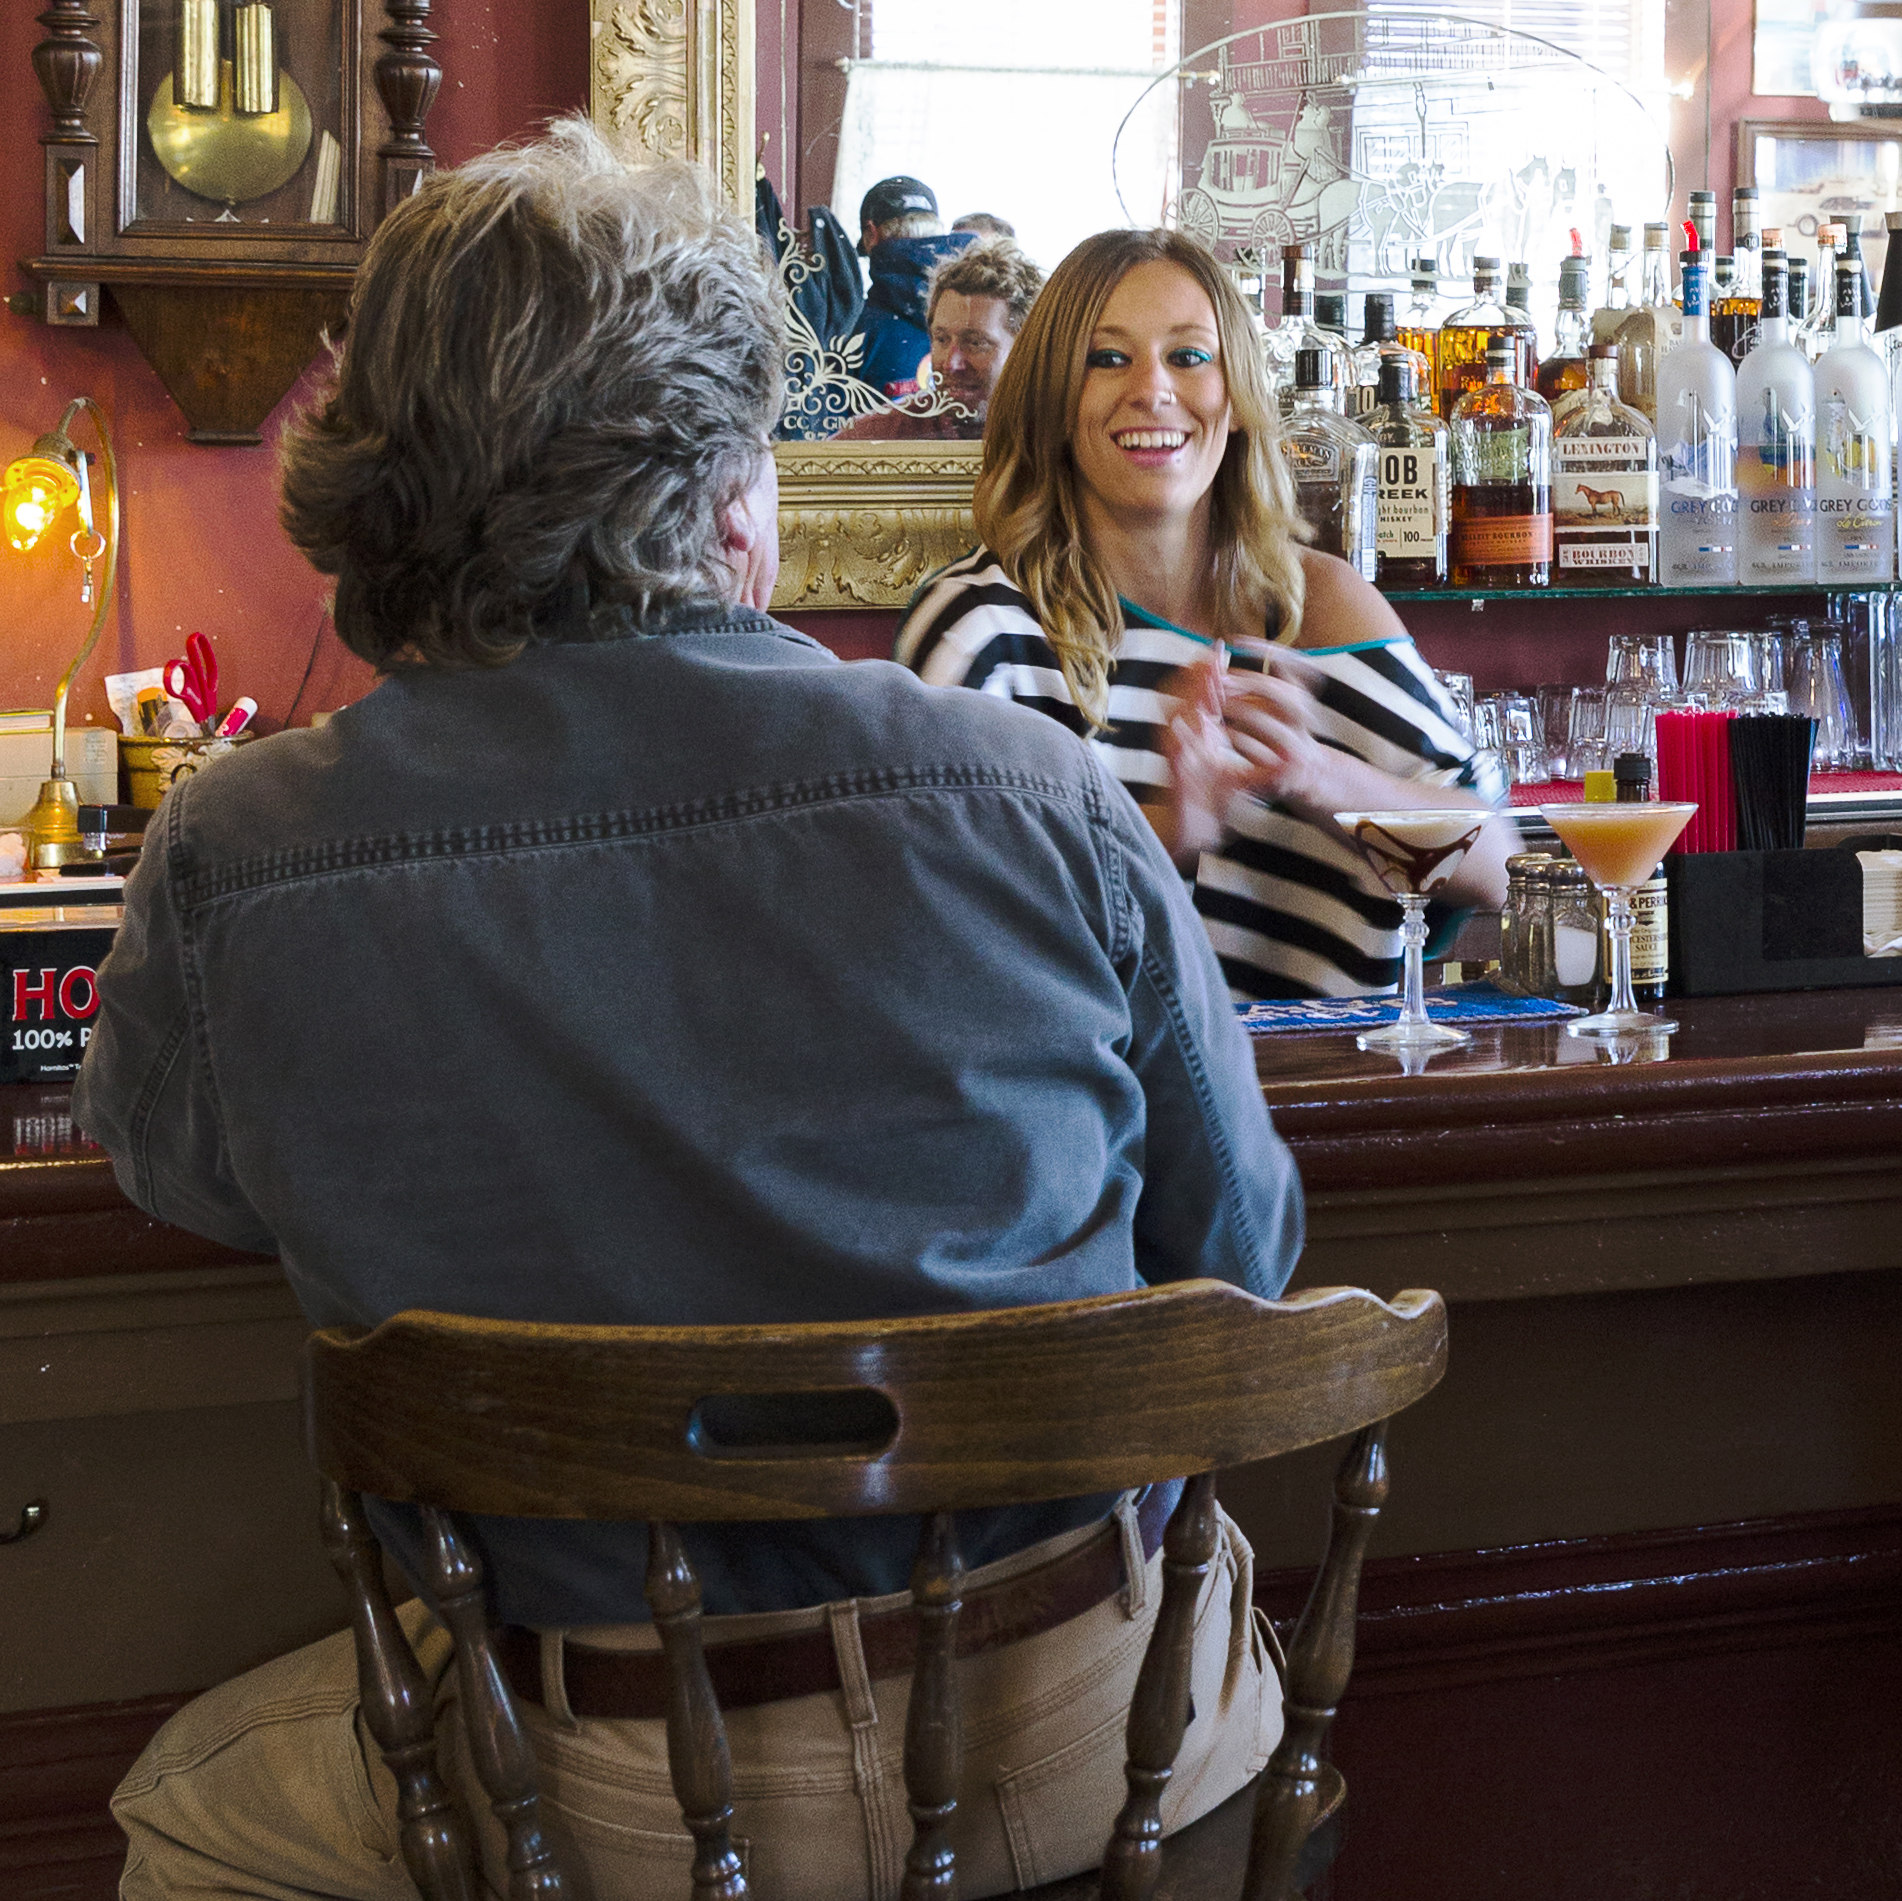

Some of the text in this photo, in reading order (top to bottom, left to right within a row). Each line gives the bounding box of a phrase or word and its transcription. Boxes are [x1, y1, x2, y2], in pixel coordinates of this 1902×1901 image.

[1563, 442, 1640, 456] LEXINGTON
[1379, 454, 1418, 486] OB
[1379, 489, 1428, 499] REEK
[1671, 500, 1707, 514] GREY
[1750, 500, 1786, 513] GREY
[1819, 499, 1852, 512] GREY
[1403, 531, 1420, 543] 100
[1572, 549, 1634, 559] BOURBON
[12, 1029, 73, 1050] 100%
